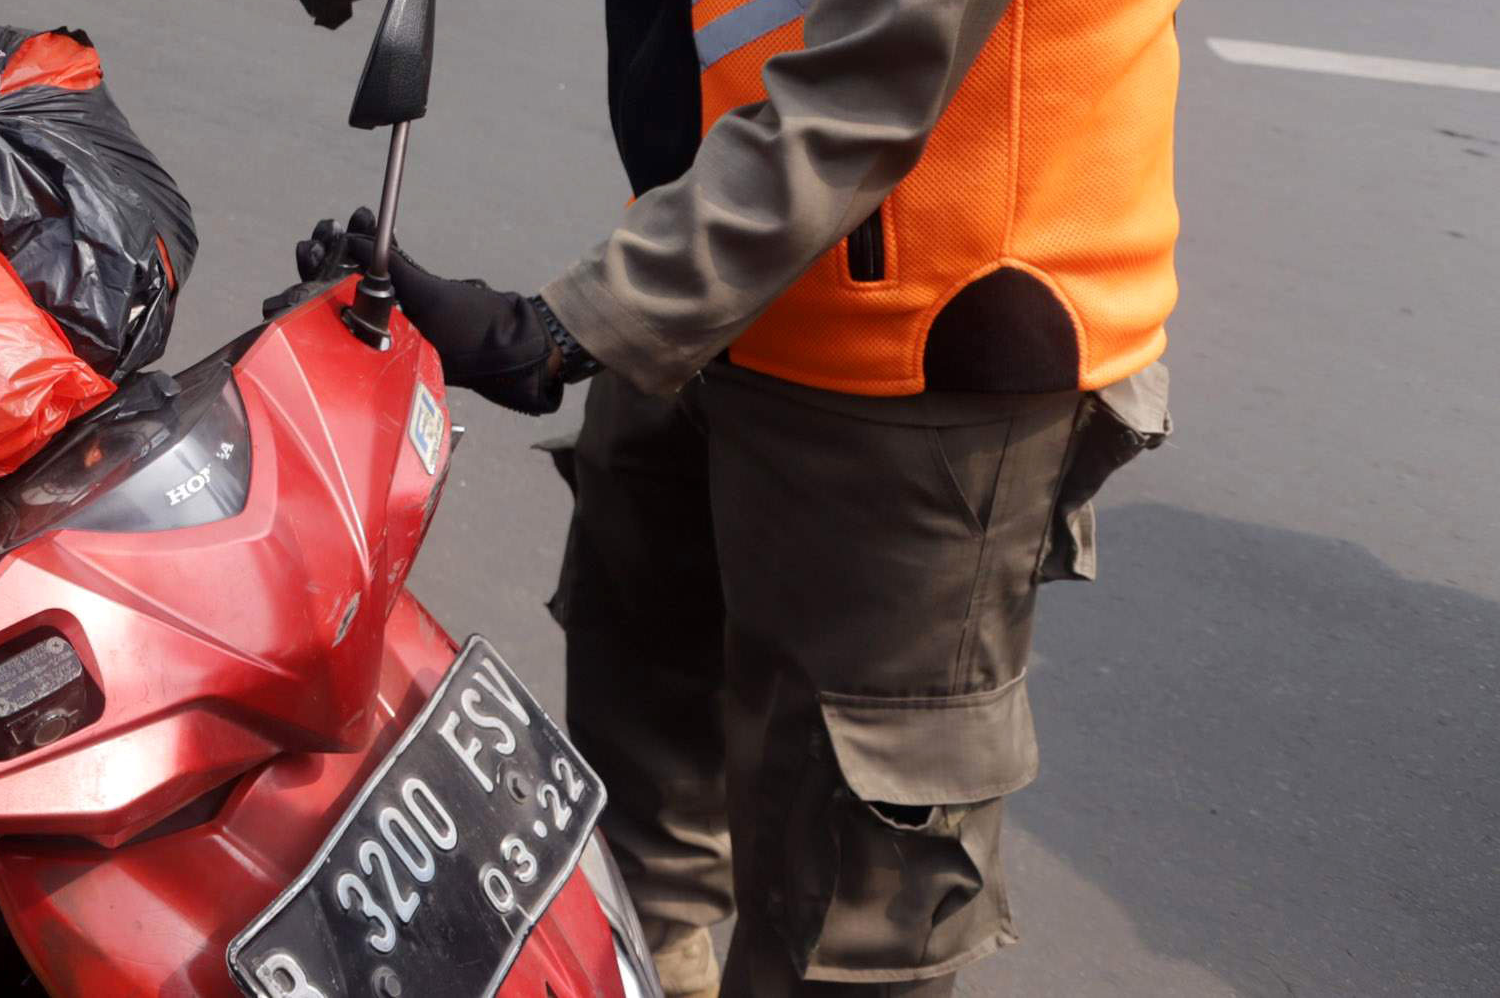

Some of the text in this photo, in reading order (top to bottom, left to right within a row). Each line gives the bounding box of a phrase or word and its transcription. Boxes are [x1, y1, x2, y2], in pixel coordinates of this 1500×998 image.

[166, 442, 234, 506] HOA
[337, 777, 457, 953] 3200
[438, 657, 530, 793] FSV
